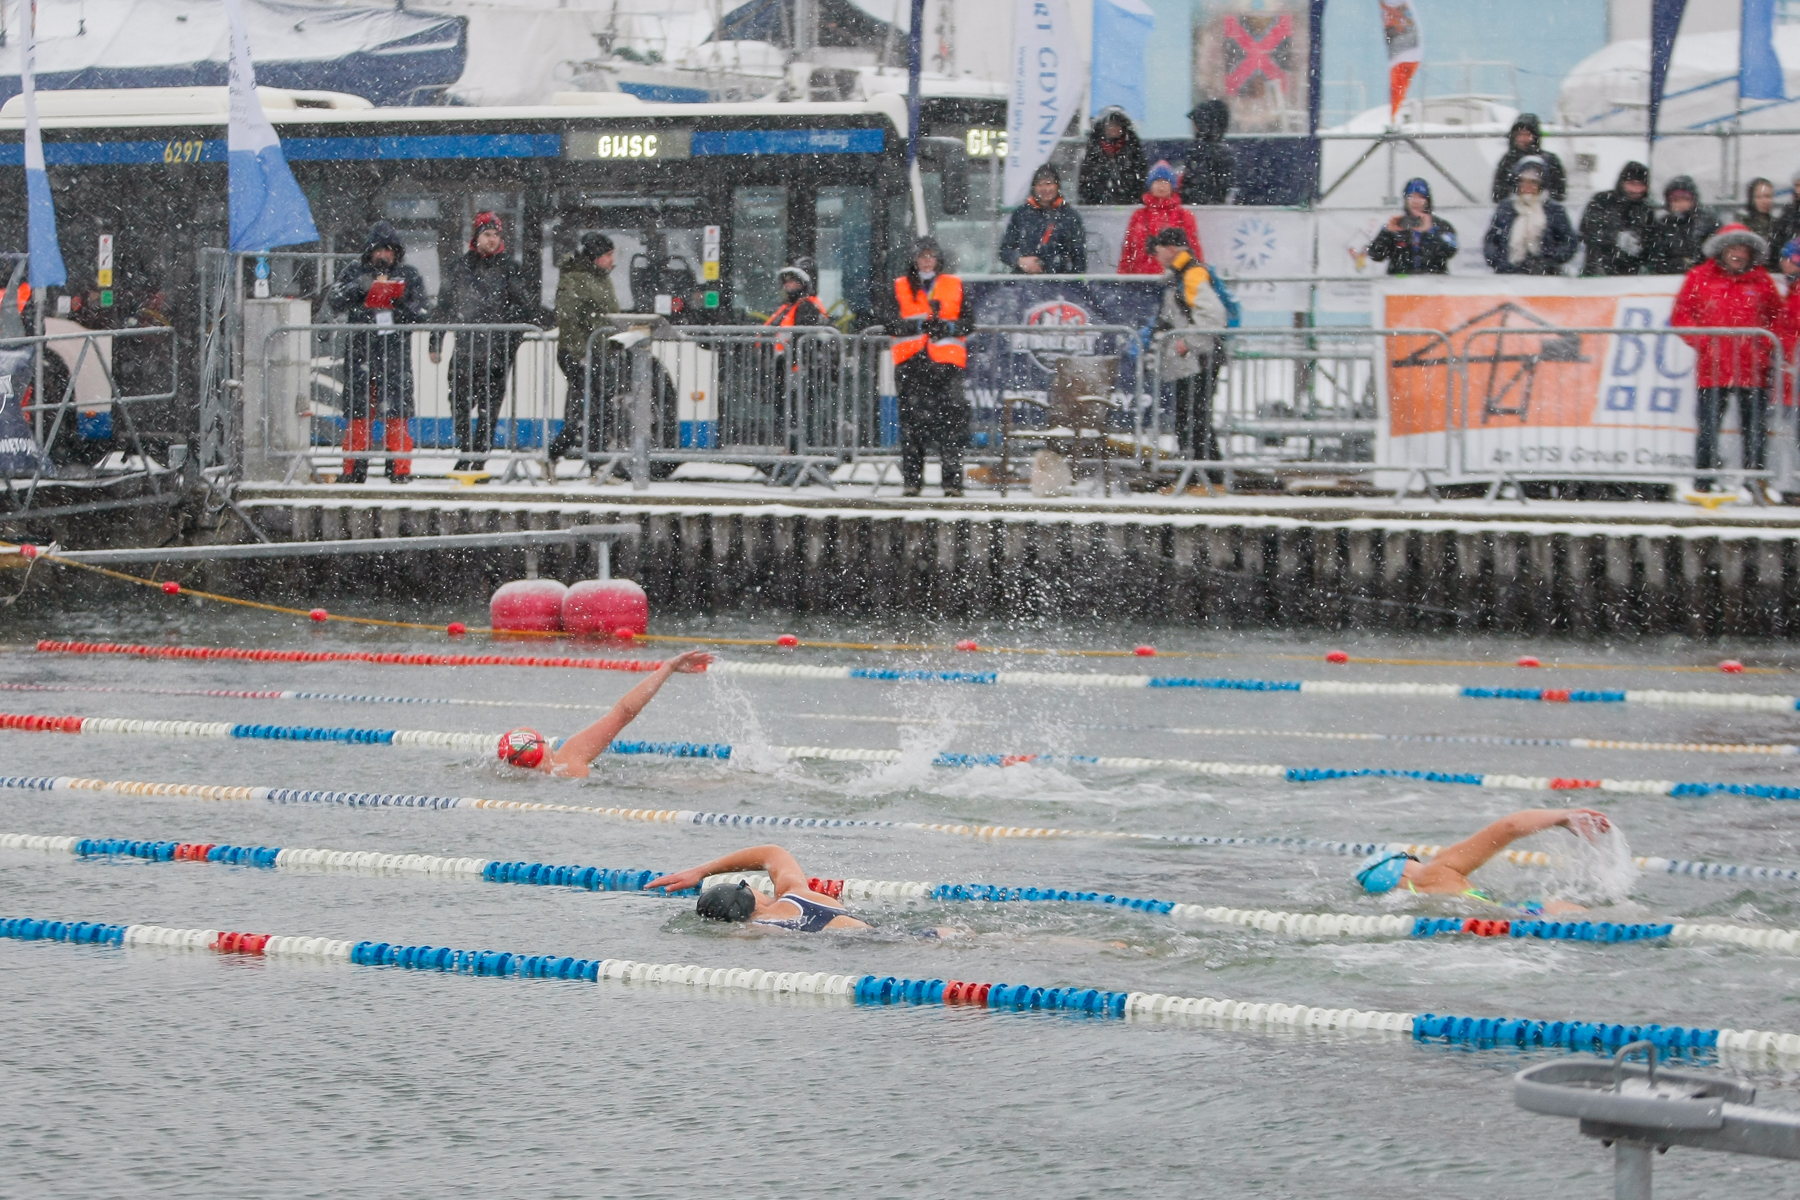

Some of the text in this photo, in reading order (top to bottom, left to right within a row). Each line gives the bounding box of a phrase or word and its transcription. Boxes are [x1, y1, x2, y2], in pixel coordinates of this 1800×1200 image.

[1034, 0, 1053, 35] RT
[164, 140, 203, 163] 6297
[598, 134, 658, 158] GWSC
